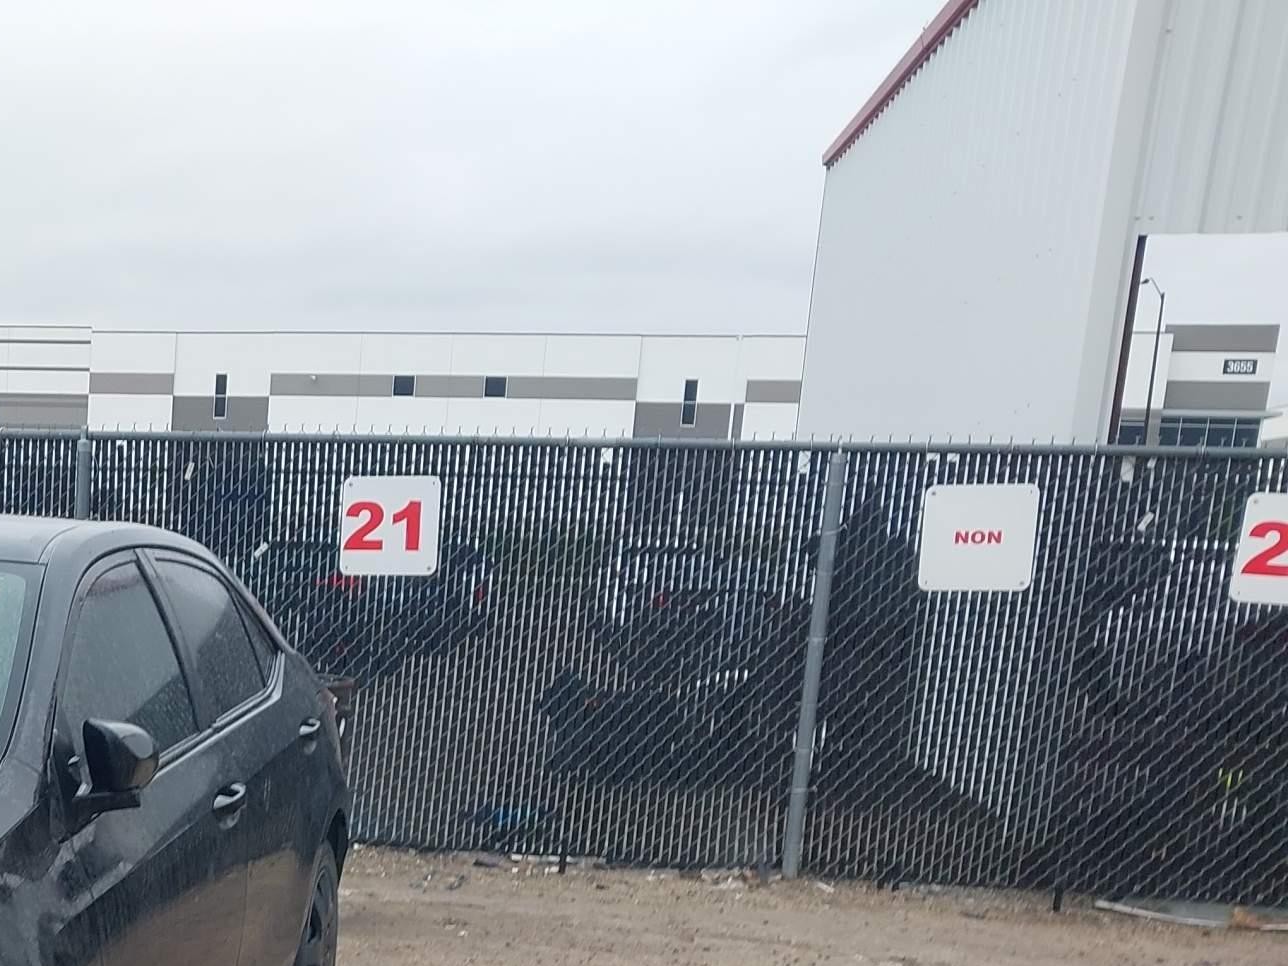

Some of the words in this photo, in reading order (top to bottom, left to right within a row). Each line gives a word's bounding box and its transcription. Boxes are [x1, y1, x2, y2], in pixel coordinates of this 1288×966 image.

[1227, 361, 1254, 373] 3655
[343, 501, 421, 550] 21
[954, 530, 1002, 544] NON
